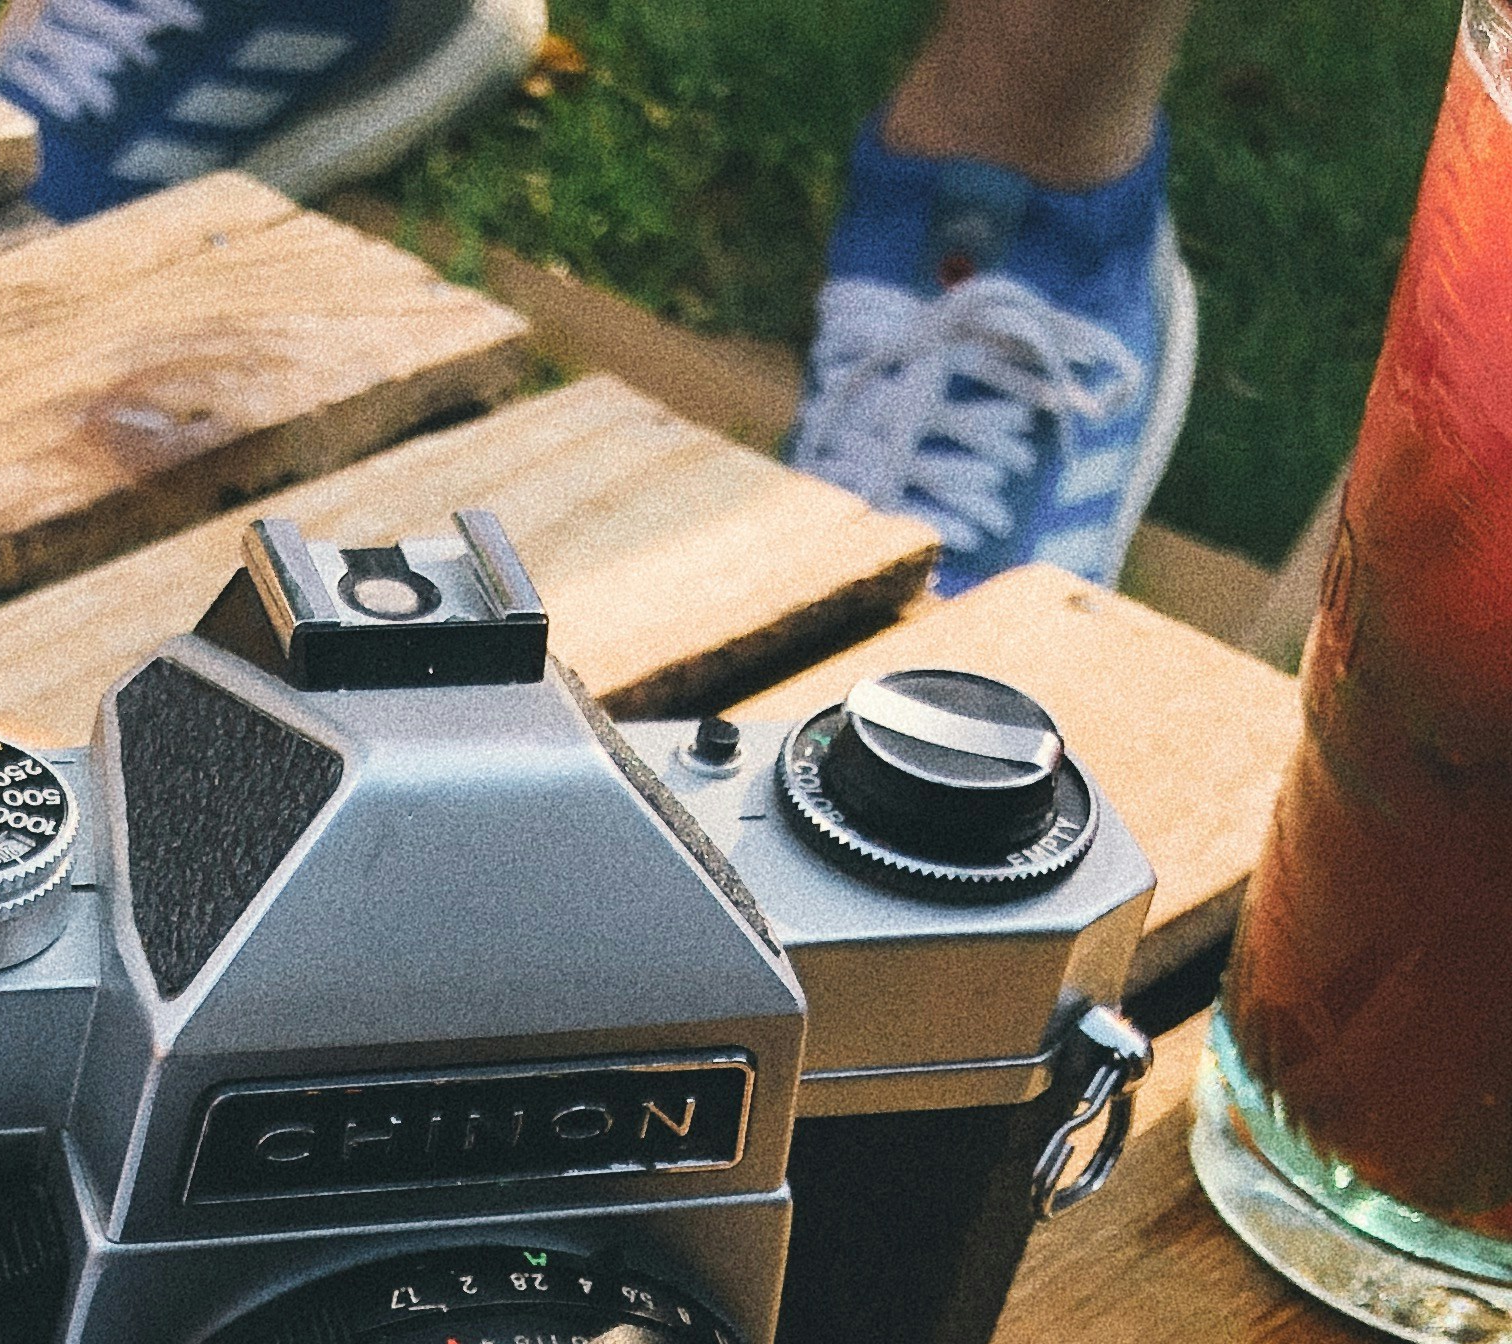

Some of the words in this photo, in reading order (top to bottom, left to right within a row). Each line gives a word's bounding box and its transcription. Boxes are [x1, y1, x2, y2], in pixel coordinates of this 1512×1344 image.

[2, 788, 61, 806] 500
[1005, 815, 1081, 869] EMPTY
[459, 1275, 478, 1295] 2
[510, 1272, 549, 1291] 2.8
[578, 1277, 593, 1295] 4
[391, 1287, 420, 1310] 1.7
